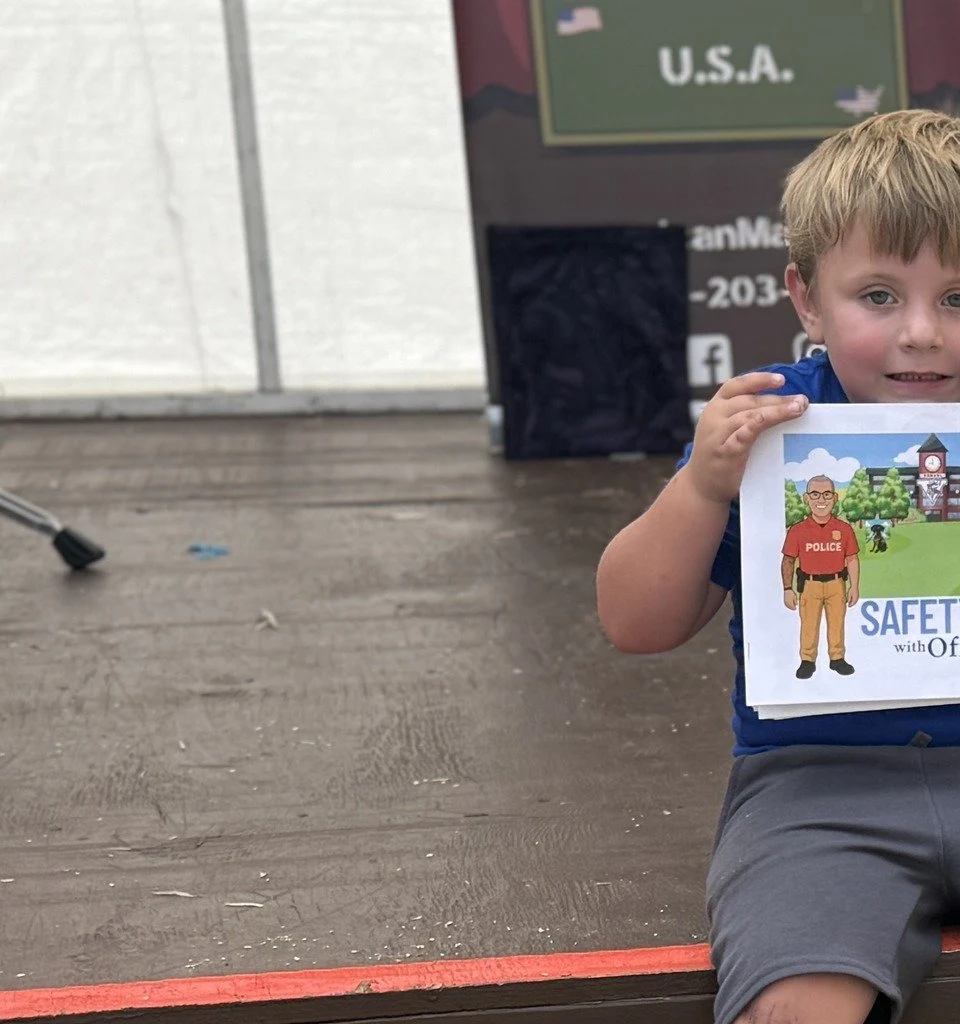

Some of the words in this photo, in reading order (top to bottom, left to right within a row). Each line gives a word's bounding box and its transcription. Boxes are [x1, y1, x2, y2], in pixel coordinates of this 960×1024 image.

[658, 44, 795, 86] U.S.A.
[805, 542, 842, 552] POLICE
[893, 640, 926, 653] with
